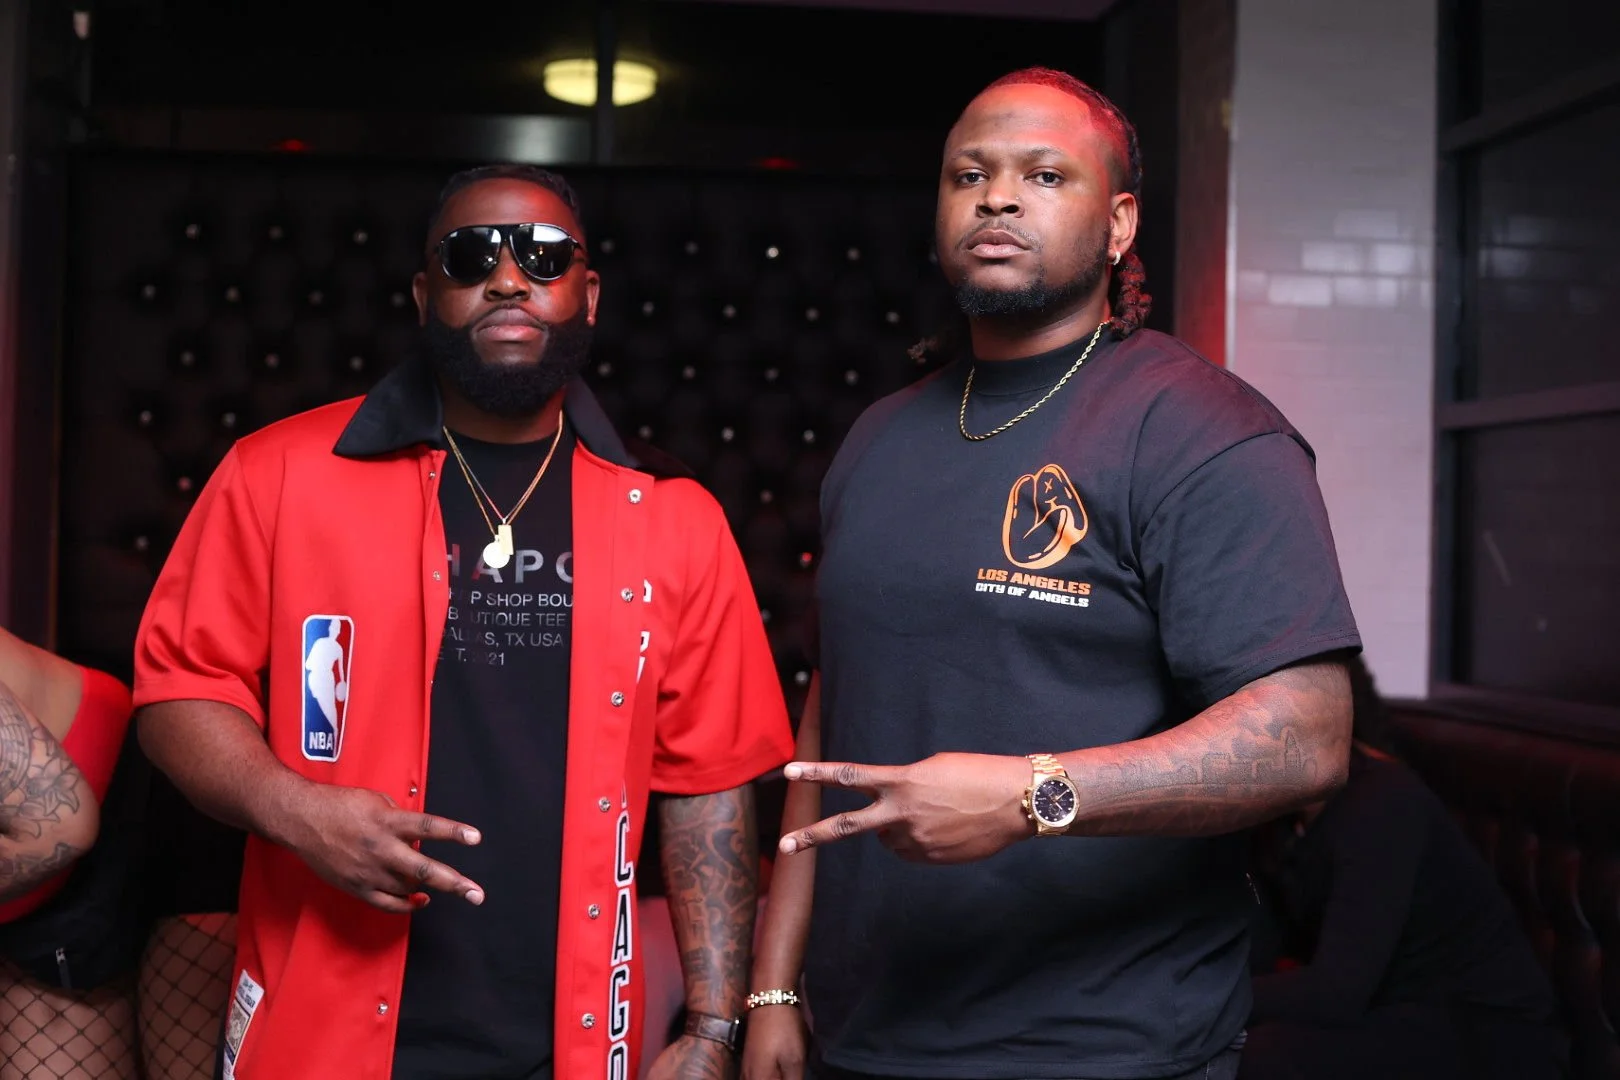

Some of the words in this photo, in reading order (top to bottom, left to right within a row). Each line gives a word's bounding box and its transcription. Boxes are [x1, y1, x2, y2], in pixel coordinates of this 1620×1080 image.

[977, 568, 1008, 582] LOS
[1010, 572, 1091, 596] ANGELES
[486, 592, 533, 607] SHOP
[975, 582, 1005, 594] CITY
[1007, 585, 1027, 597] OF
[1028, 590, 1089, 608] ANGELS
[535, 612, 567, 627] TEE
[505, 632, 525, 646] TX
[530, 632, 564, 647] USA
[309, 731, 334, 751] NBA
